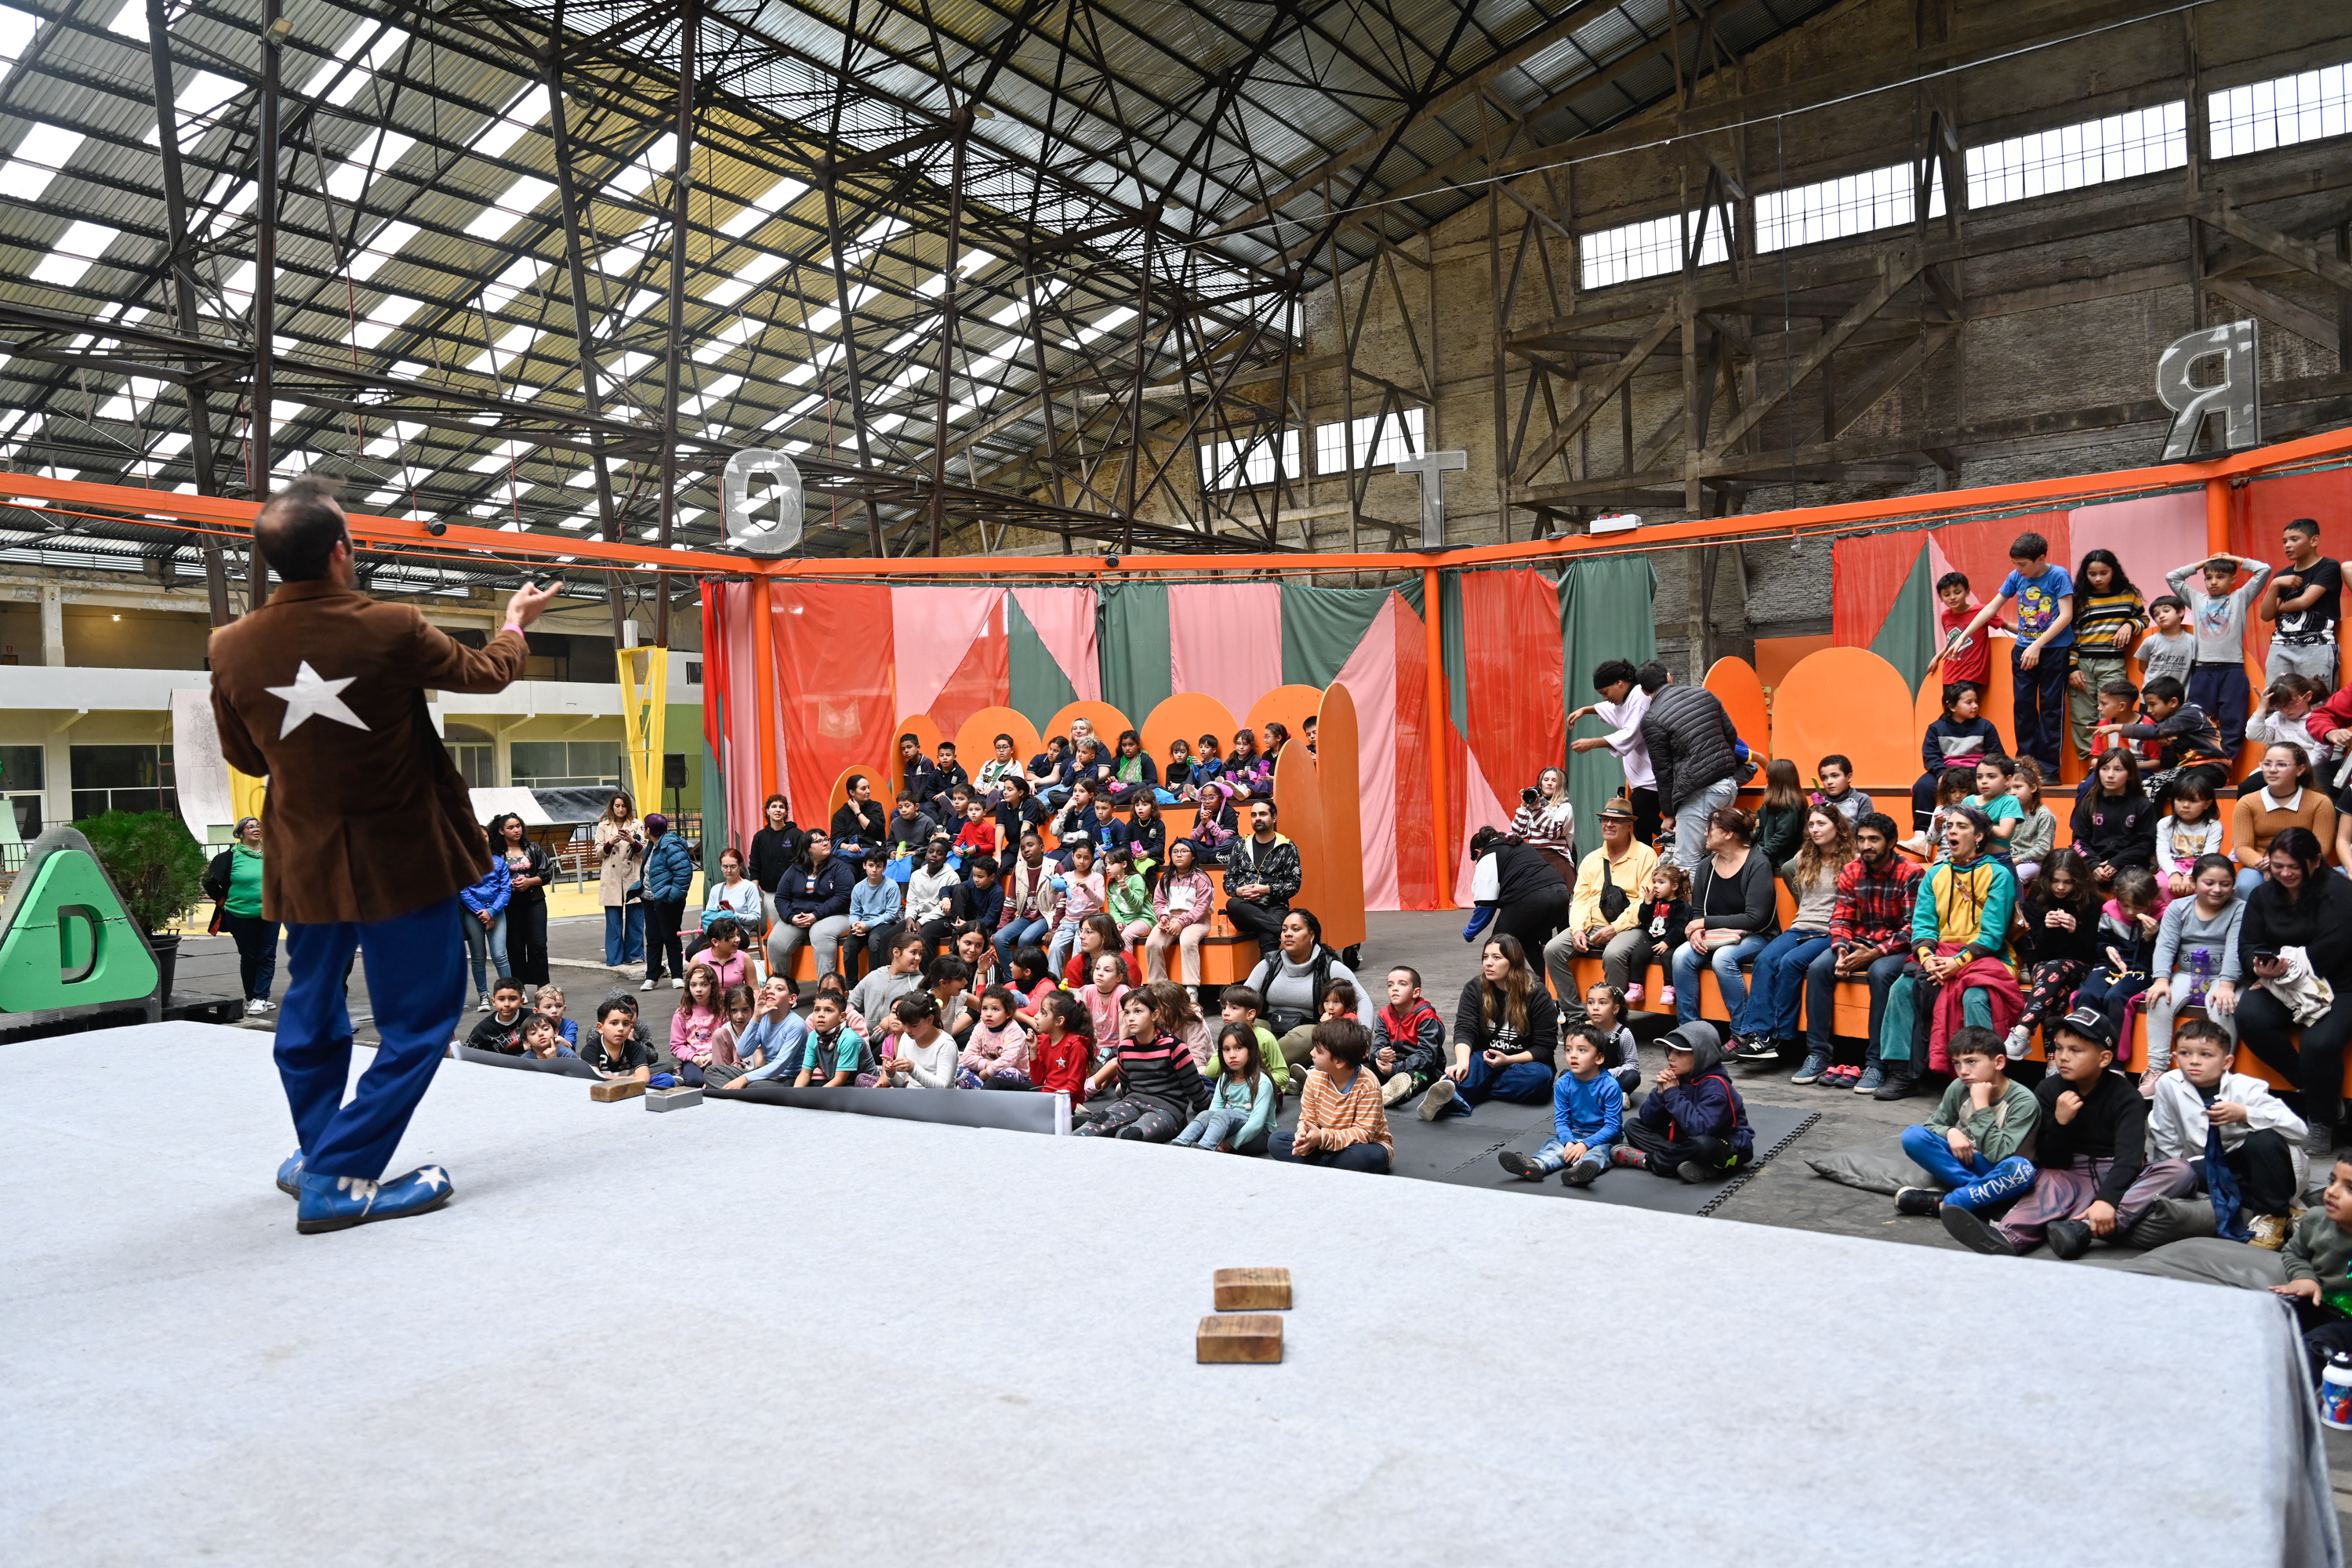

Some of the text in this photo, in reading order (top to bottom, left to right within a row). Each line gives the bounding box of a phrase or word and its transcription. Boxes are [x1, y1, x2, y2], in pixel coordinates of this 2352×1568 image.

[722, 448, 804, 554] O
[1396, 450, 1467, 547] T
[57, 903, 108, 985] D
[599, 1054, 608, 1069] 2
[1977, 1162, 2028, 1201] BRKLN
